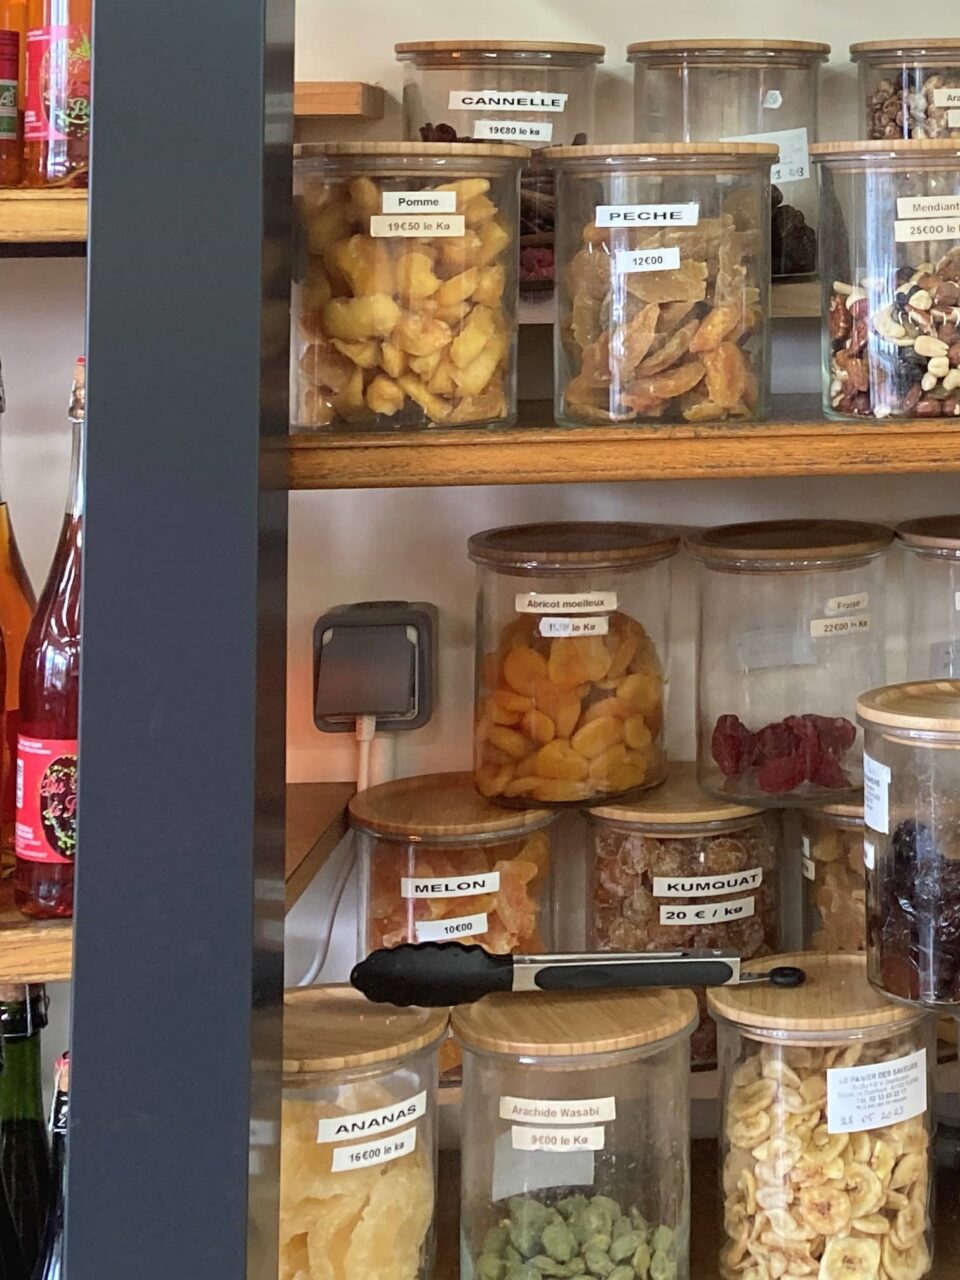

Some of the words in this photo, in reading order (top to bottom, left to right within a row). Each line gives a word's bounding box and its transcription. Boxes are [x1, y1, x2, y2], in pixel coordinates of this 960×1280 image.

[461, 97, 561, 108] CANNELLE
[488, 125, 517, 135] 19€80
[518, 126, 527, 135] le
[397, 197, 440, 207] Pomme
[912, 202, 960, 212] Mendiant
[609, 211, 683, 221] PECHE
[387, 221, 420, 231] 19€50
[423, 221, 433, 231] le
[947, 224, 956, 233] le
[632, 255, 664, 266] 12€00
[527, 599, 560, 609] Abricot
[562, 599, 605, 608] moelleux
[414, 880, 486, 893] MELON
[667, 874, 759, 892] KUMQUAT
[665, 911, 687, 920] 20
[694, 910, 706, 919] €
[724, 905, 743, 916] kg
[444, 922, 473, 934] 10€00
[511, 1104, 557, 1118] Arachide
[560, 1106, 600, 1118] Wasabi
[335, 1104, 417, 1135] ANANAS
[560, 1135, 571, 1145] le
[350, 1148, 381, 1163] 16€00
[383, 1145, 392, 1155] le
